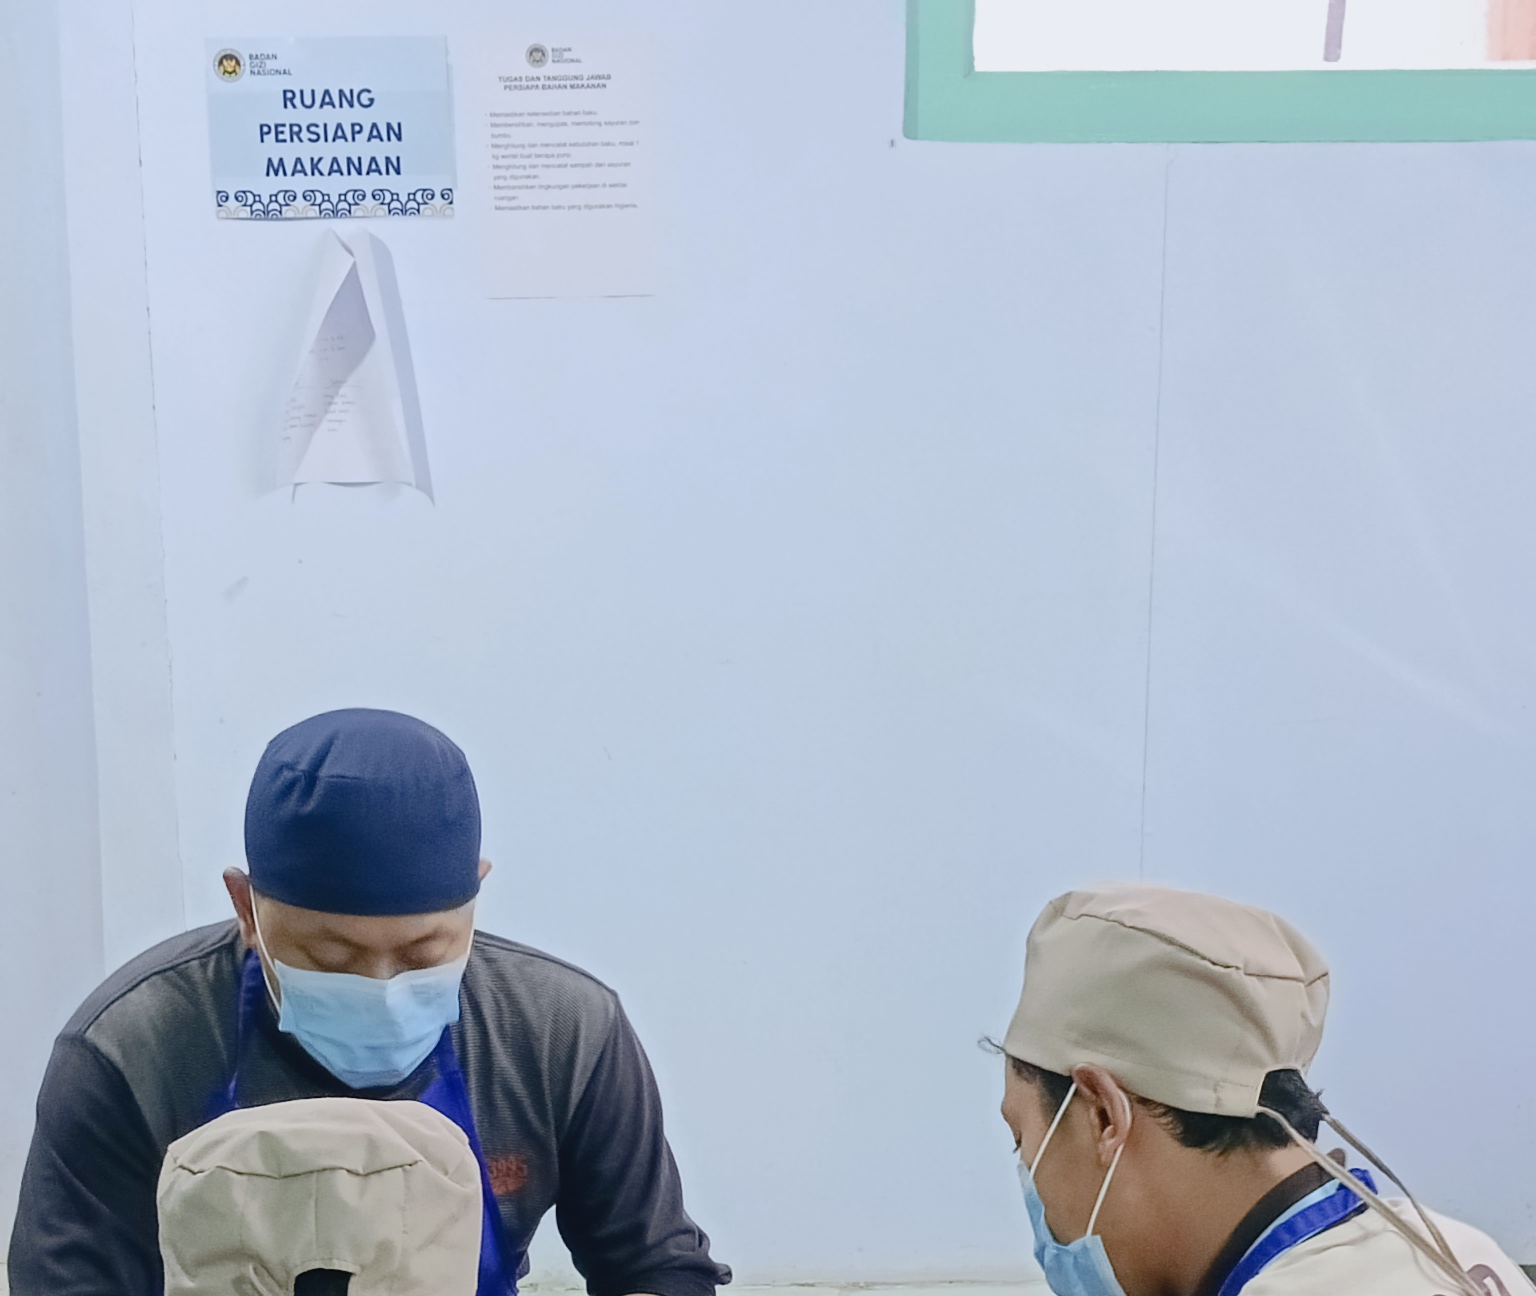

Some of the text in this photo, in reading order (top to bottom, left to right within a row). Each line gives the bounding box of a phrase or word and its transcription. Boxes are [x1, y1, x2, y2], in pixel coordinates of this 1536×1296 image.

[248, 53, 278, 61] BADAN
[249, 68, 293, 76] NASIONAL
[543, 74, 584, 82] TANGGUNG
[282, 88, 376, 109] RUANG
[259, 122, 403, 143] PERSIAPAN
[265, 156, 402, 177] MAKANAN
